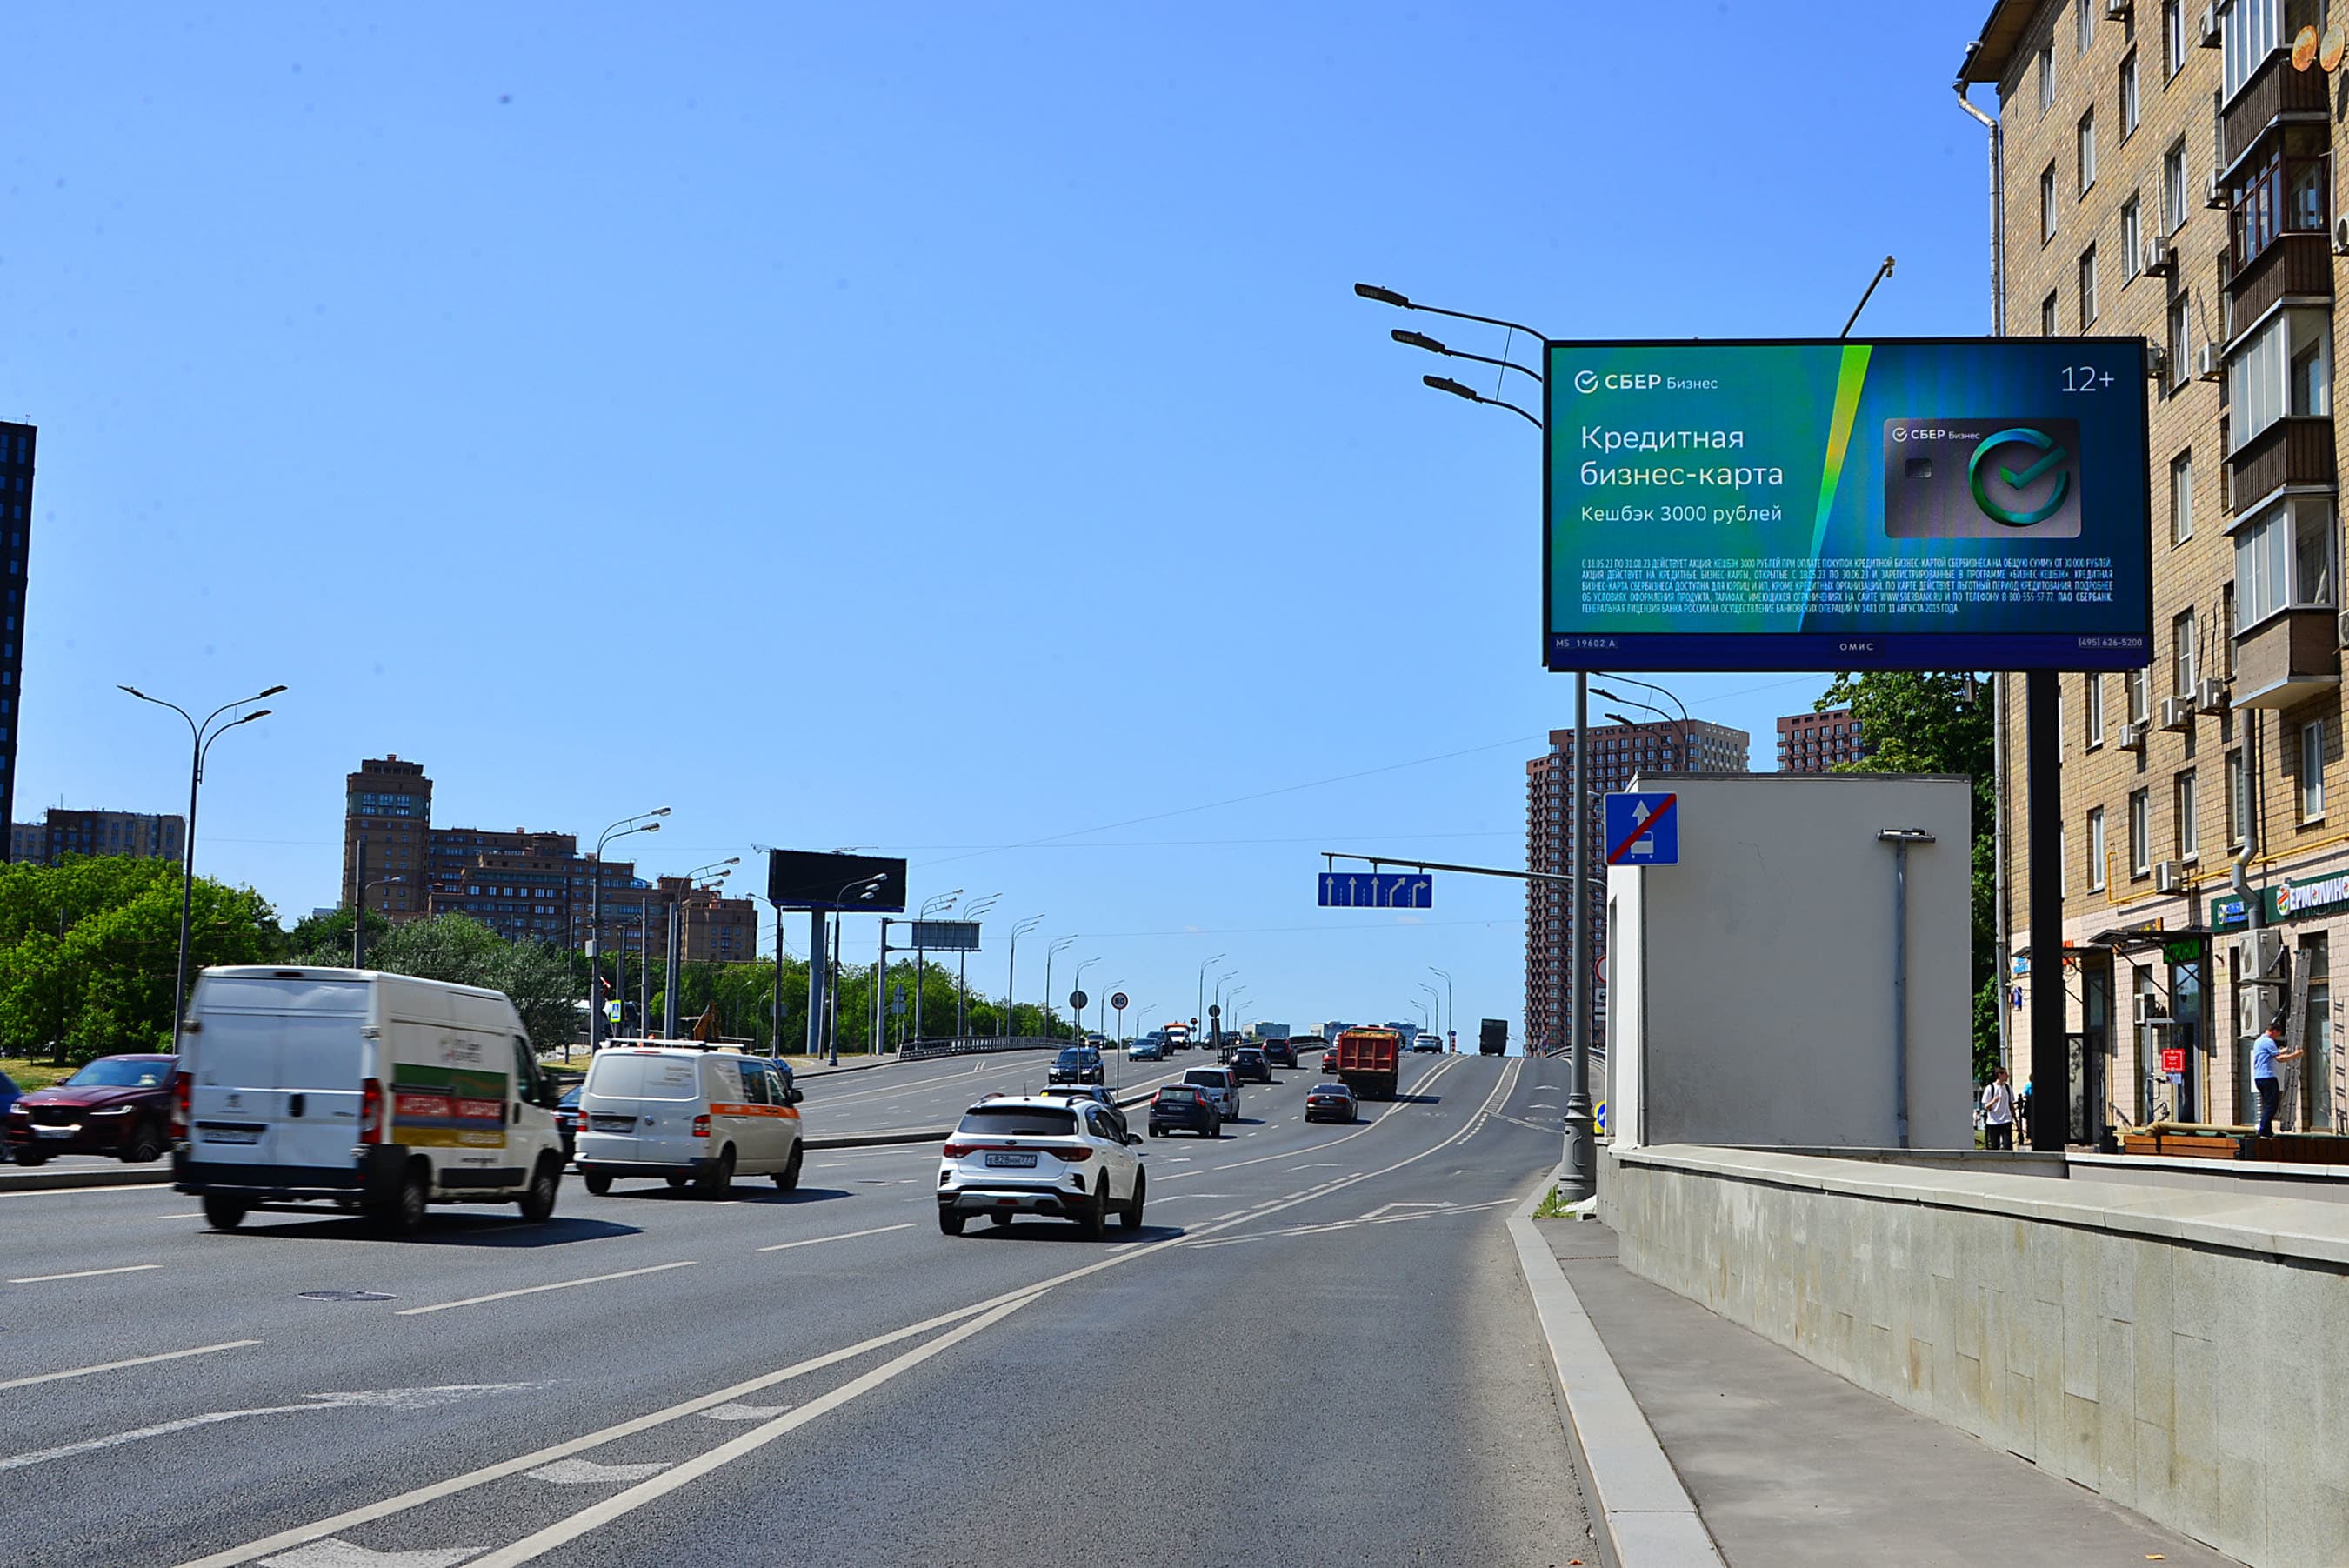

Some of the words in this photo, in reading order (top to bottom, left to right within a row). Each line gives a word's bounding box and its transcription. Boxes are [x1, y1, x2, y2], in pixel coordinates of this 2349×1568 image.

[1605, 374, 1662, 390] СБЕР
[1666, 377, 1718, 390] Бизнес
[2061, 366, 2115, 392] 12+
[1581, 425, 1745, 454] Кредитная
[1911, 430, 1945, 440] СБЕР
[1948, 430, 1980, 440] Бизнес
[1580, 460, 1784, 490] бизнес-карта
[1581, 505, 1654, 522] Кешбэк
[1660, 505, 1707, 522] 3000
[1713, 504, 1782, 524] рублей
[2079, 637, 2100, 647] (495)
[2102, 638, 2143, 647] 626-5200
[2289, 875, 2349, 911] ЕРМОЛИНО
